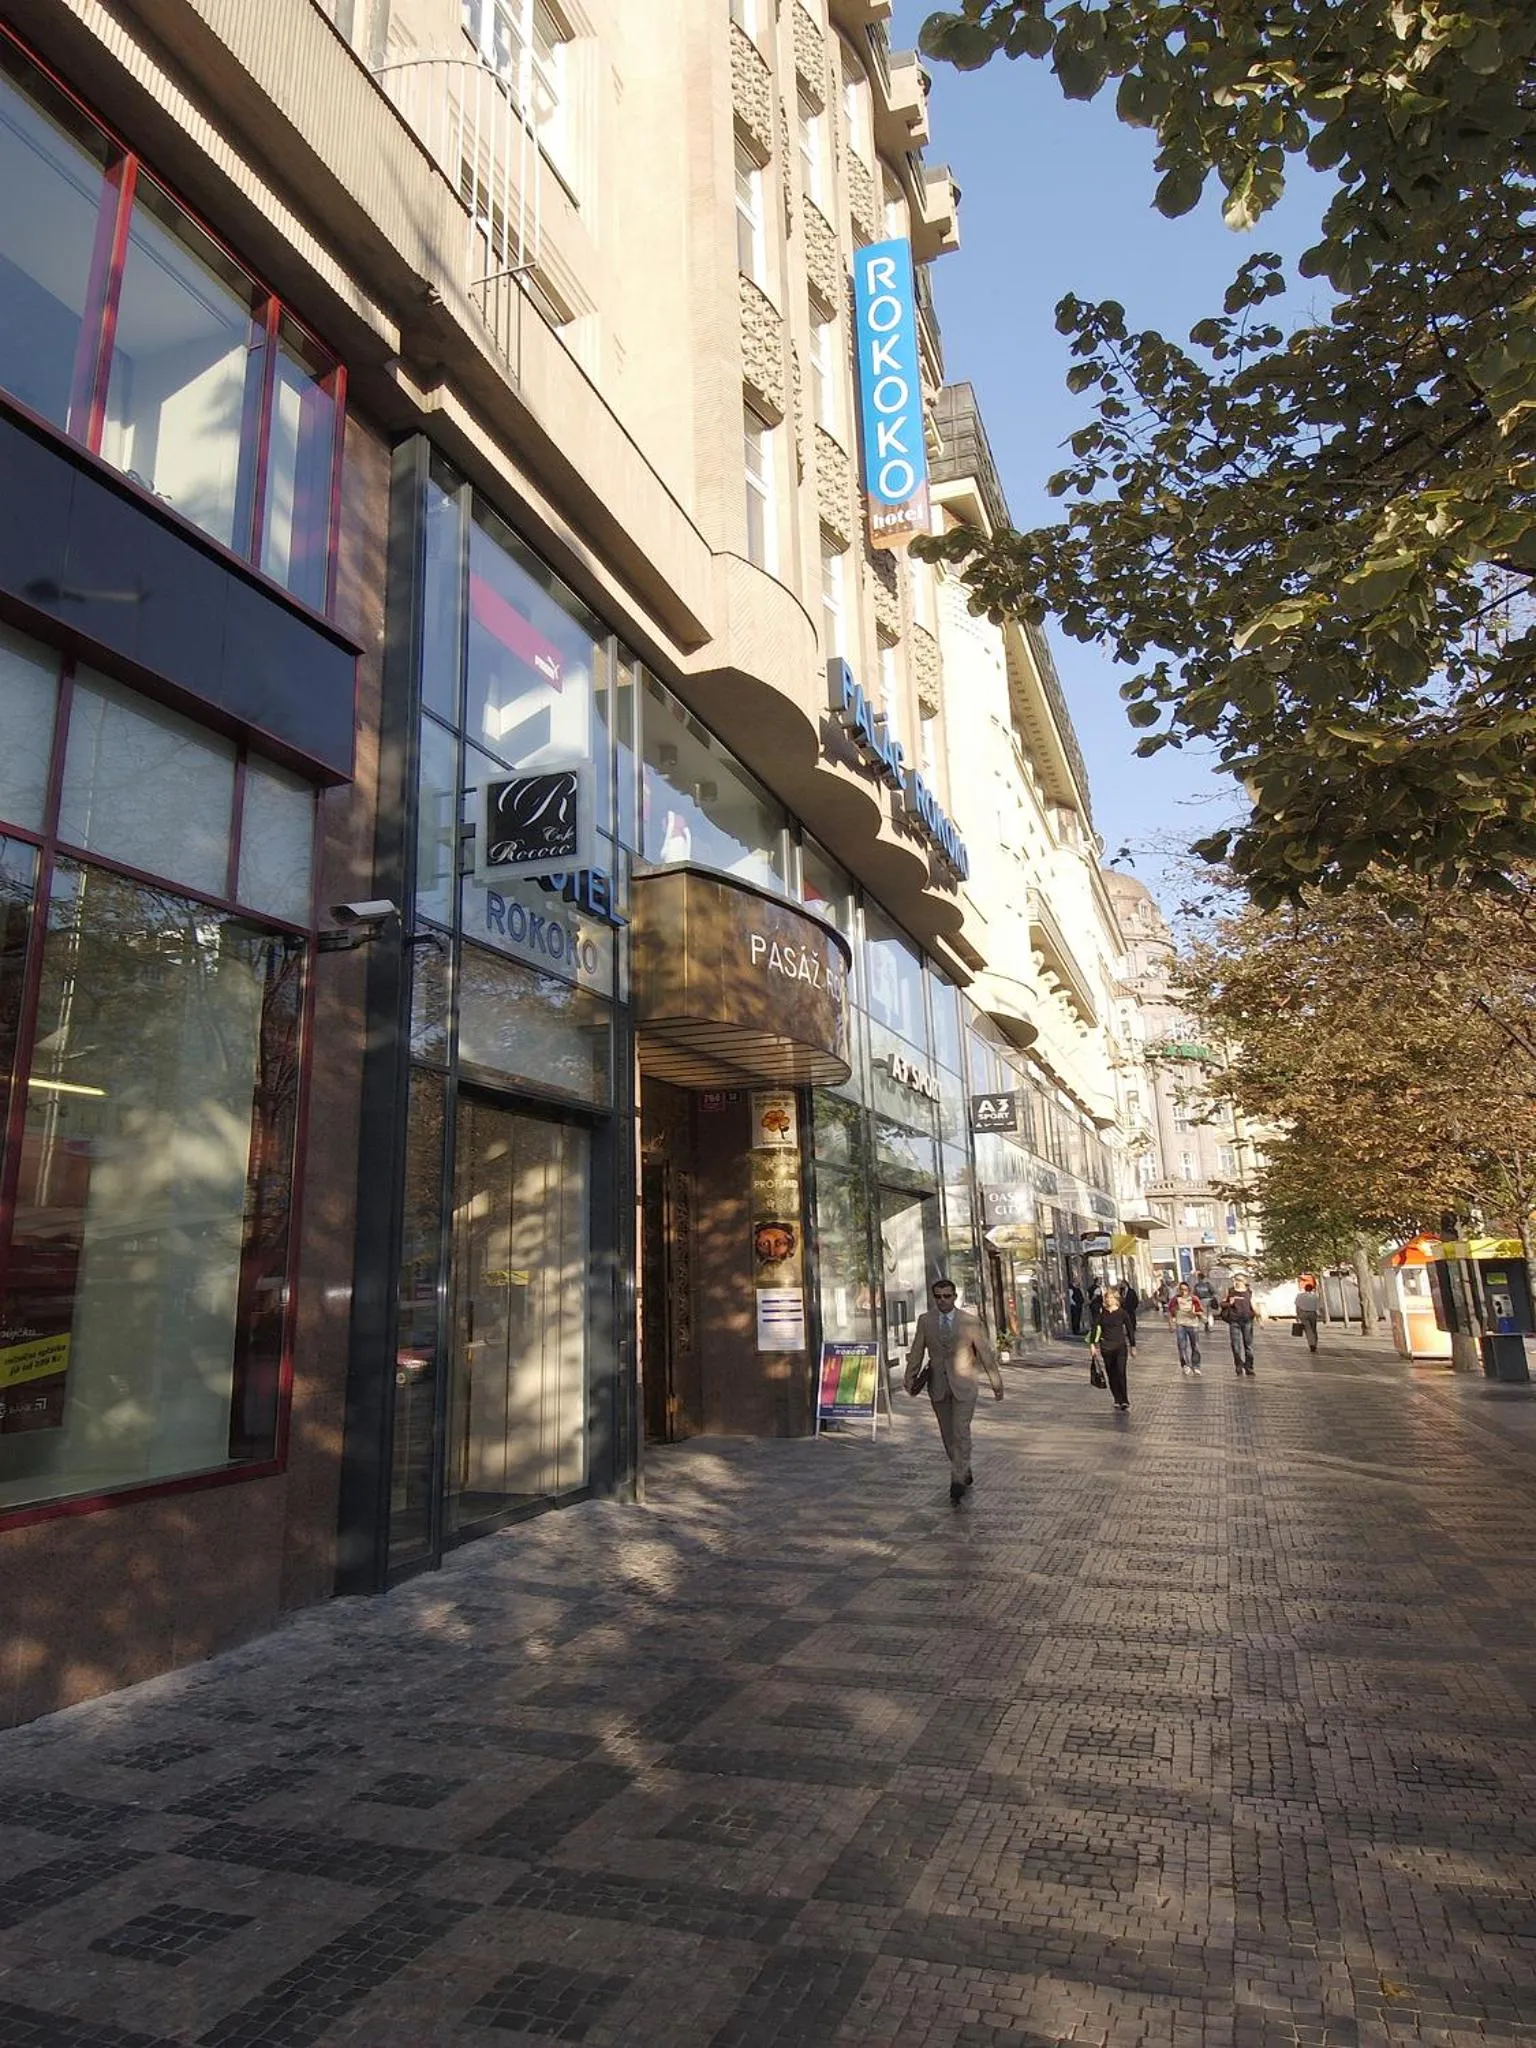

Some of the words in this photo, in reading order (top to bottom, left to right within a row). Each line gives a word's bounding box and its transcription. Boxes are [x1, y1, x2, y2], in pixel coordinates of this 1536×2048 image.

[866, 256, 915, 499] ROKOKO
[872, 503, 924, 531] hotel
[486, 889, 598, 975] ROKOKO
[750, 933, 822, 990] PASÁŽ
[910, 1064, 942, 1102] SPORT
[977, 1111, 1010, 1121] SPORT
[978, 1098, 1009, 1114] A3
[988, 1191, 1021, 1203] OAS
